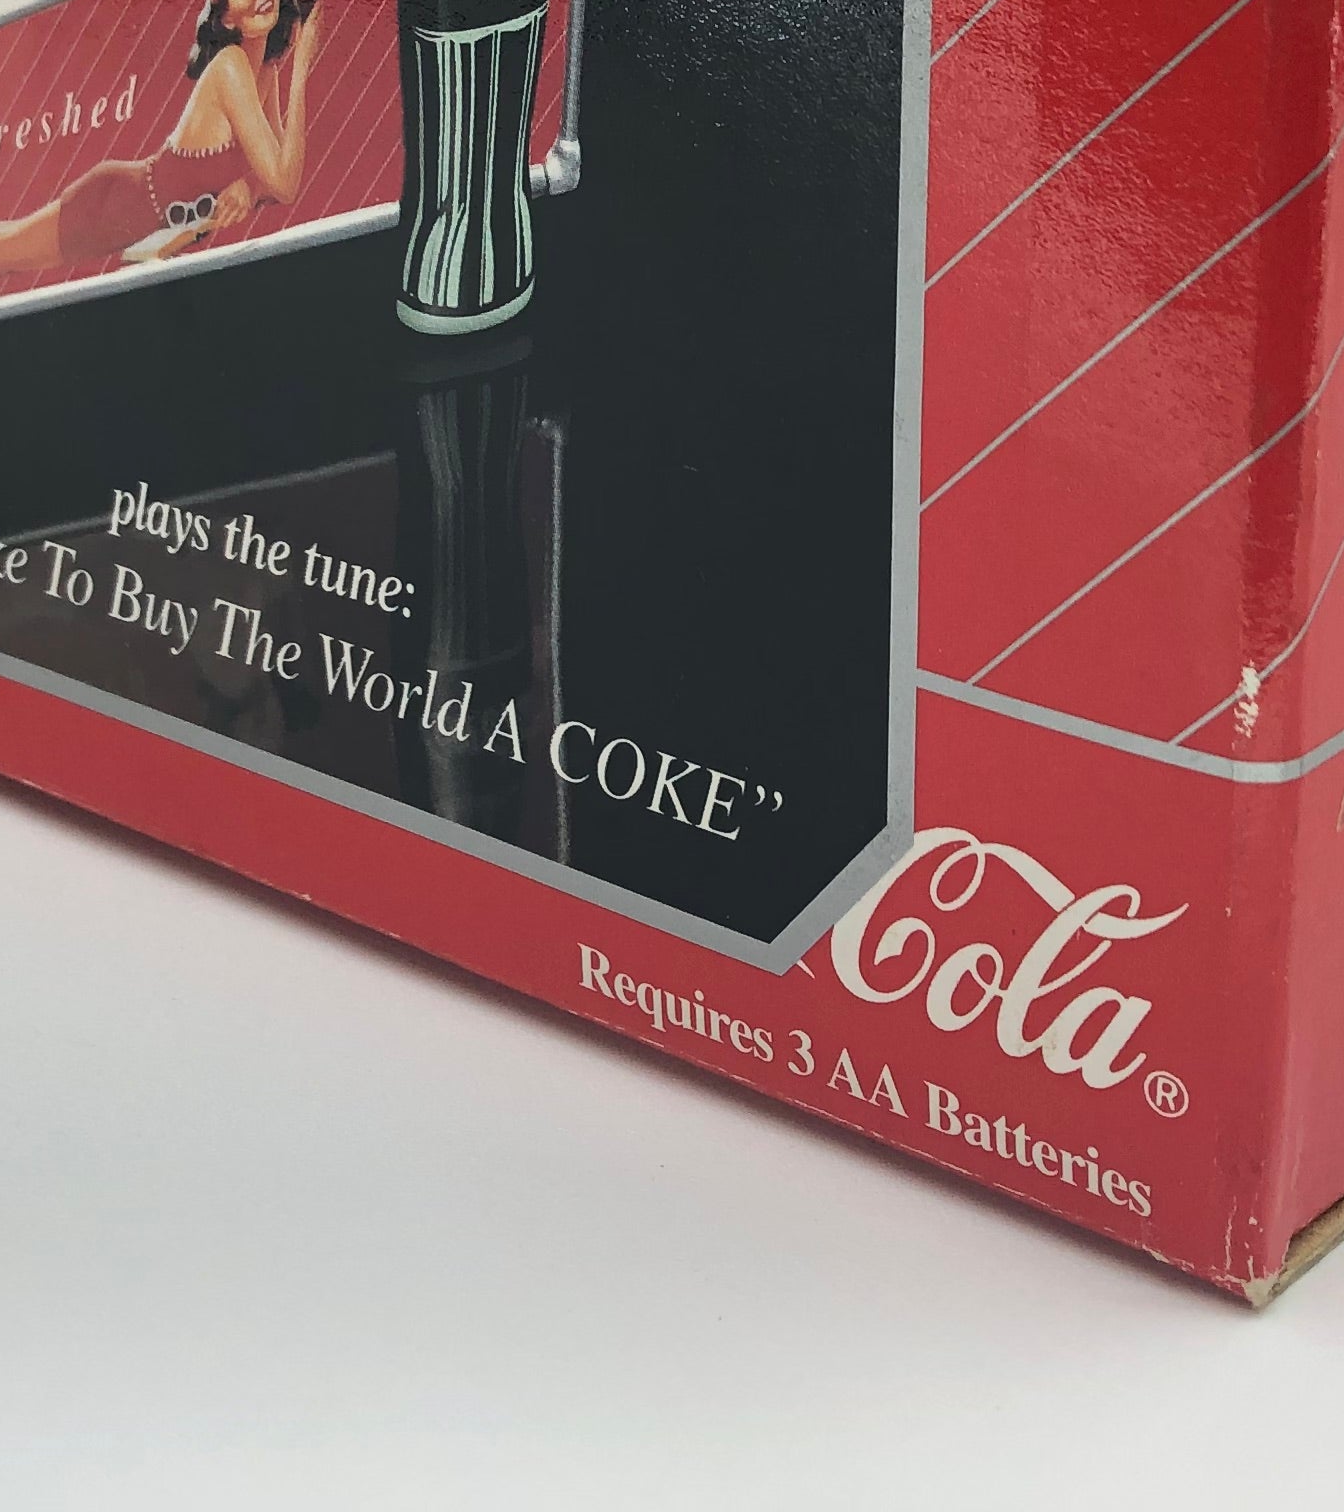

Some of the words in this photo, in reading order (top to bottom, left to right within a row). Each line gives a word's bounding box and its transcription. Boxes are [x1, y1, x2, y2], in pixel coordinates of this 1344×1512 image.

[43, 539, 94, 610] To
[107, 564, 200, 656] Buy
[213, 597, 303, 682] The
[318, 632, 473, 743] World
[484, 697, 529, 765] A
[109, 482, 211, 556] plays
[223, 513, 290, 576] the
[303, 544, 417, 619] tune:
[576, 942, 775, 1063] Requires
[787, 1029, 815, 1077] 3
[826, 1047, 910, 1118] AA
[922, 1080, 1153, 1218] Batteries
